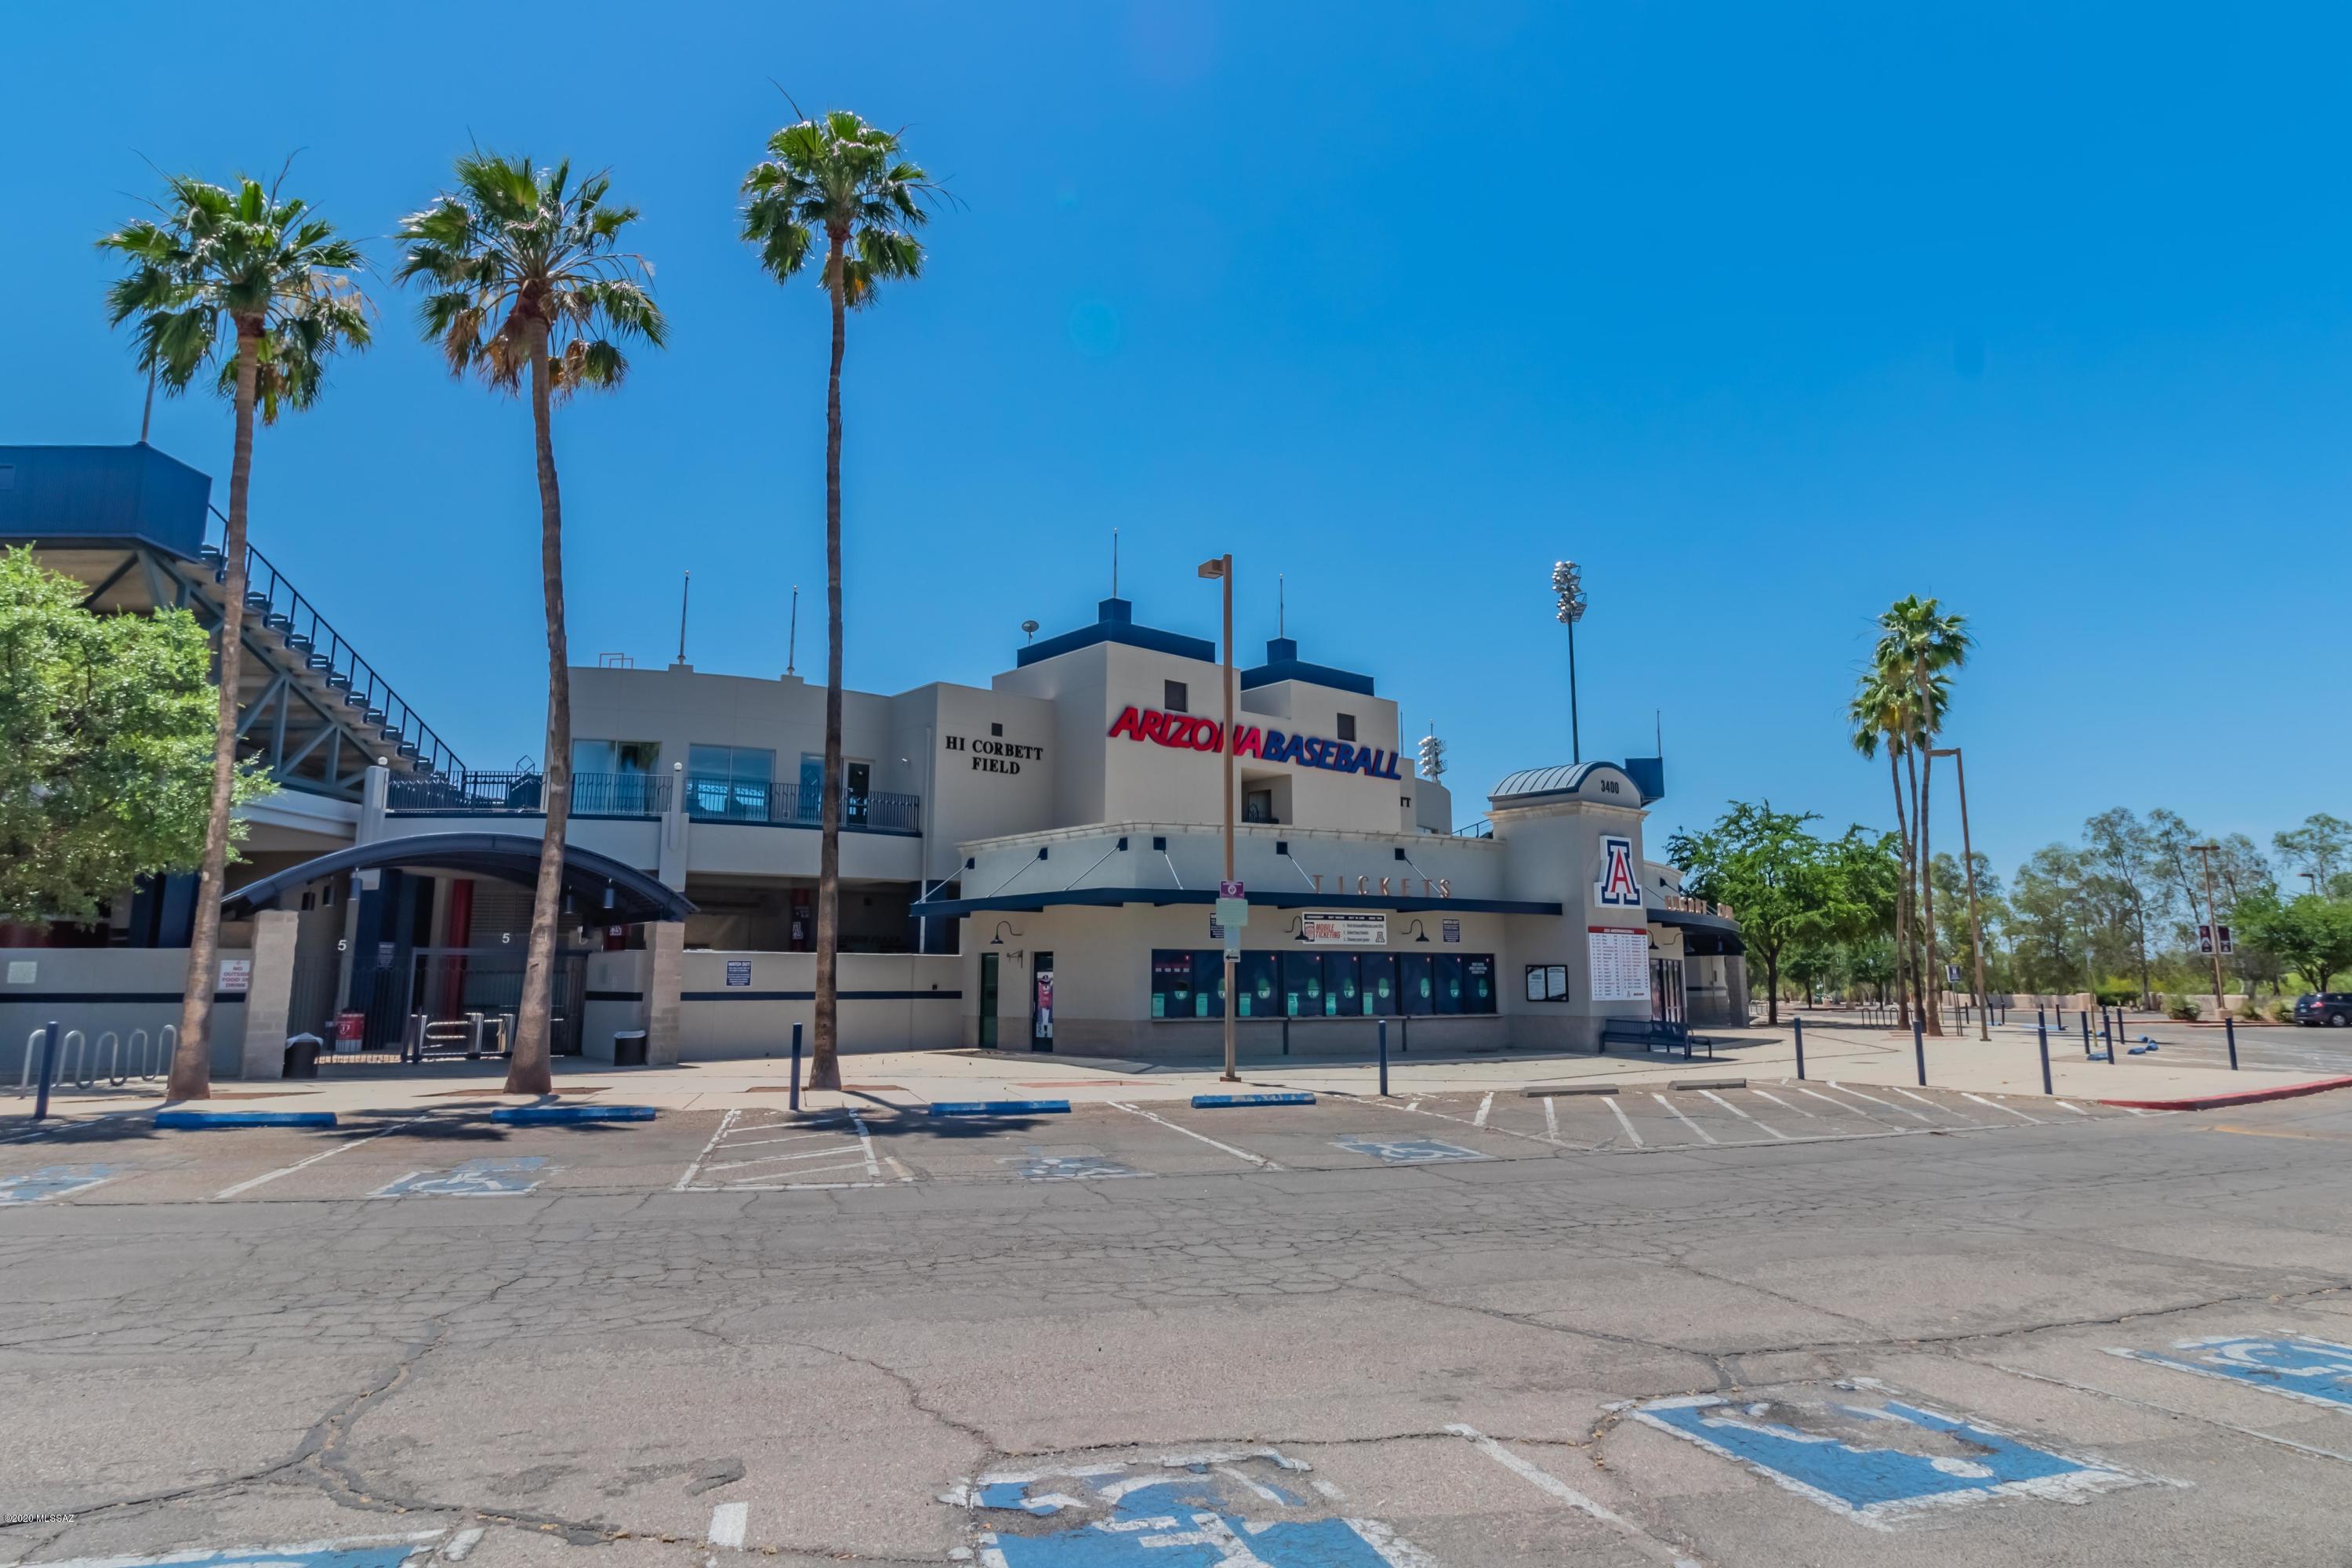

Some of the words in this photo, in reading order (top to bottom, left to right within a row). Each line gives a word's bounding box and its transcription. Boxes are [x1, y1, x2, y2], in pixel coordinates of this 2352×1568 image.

[946, 735, 966, 751] HI
[972, 739, 1044, 760] CORBETT
[1108, 706, 1263, 759] ARIZONA
[1261, 730, 1403, 781] BASEBALL
[971, 756, 1021, 775] FIELD
[1600, 779, 1620, 795] 3400
[1595, 836, 1642, 909] A
[1311, 873, 1451, 898] TICKETS
[337, 939, 347, 951] 5
[502, 933, 510, 943] 5
